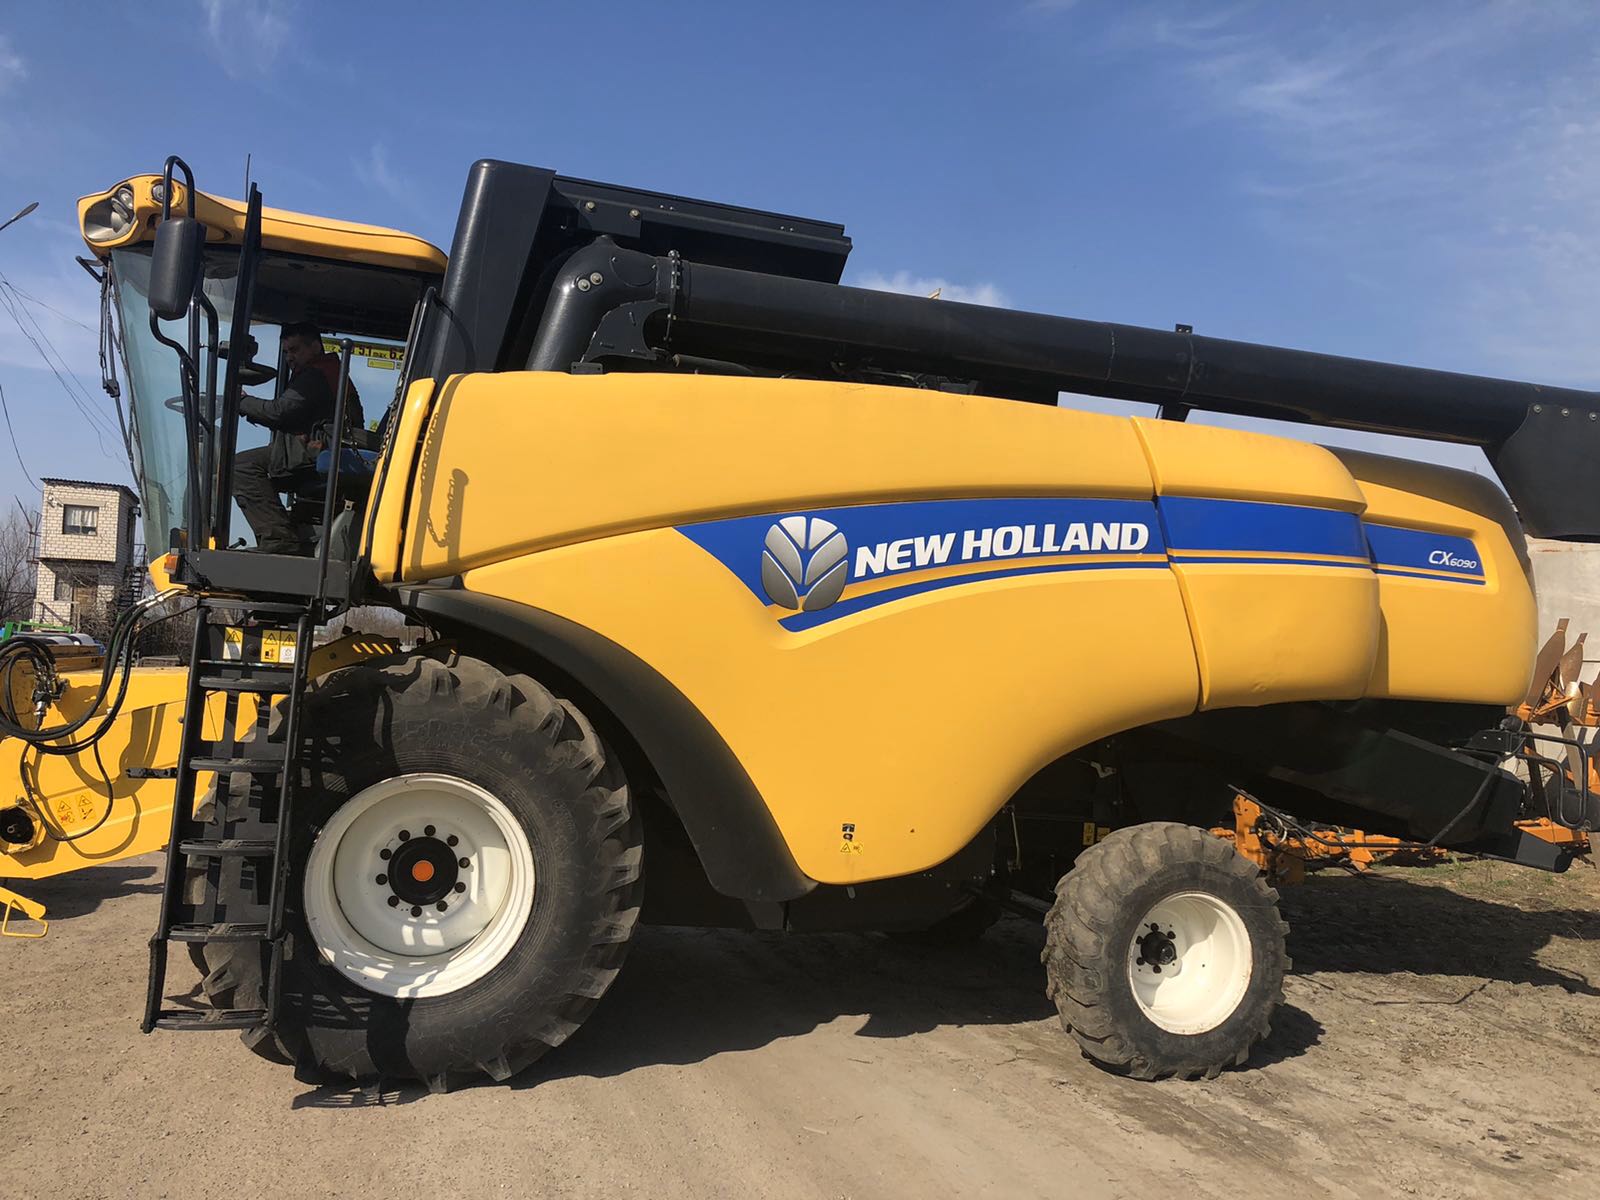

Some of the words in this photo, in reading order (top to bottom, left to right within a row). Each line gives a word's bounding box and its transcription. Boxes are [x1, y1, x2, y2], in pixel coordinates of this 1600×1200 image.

[853, 532, 956, 578] NEW
[961, 522, 1150, 560] HOLLAND
[1428, 550, 1477, 569] CX6090
